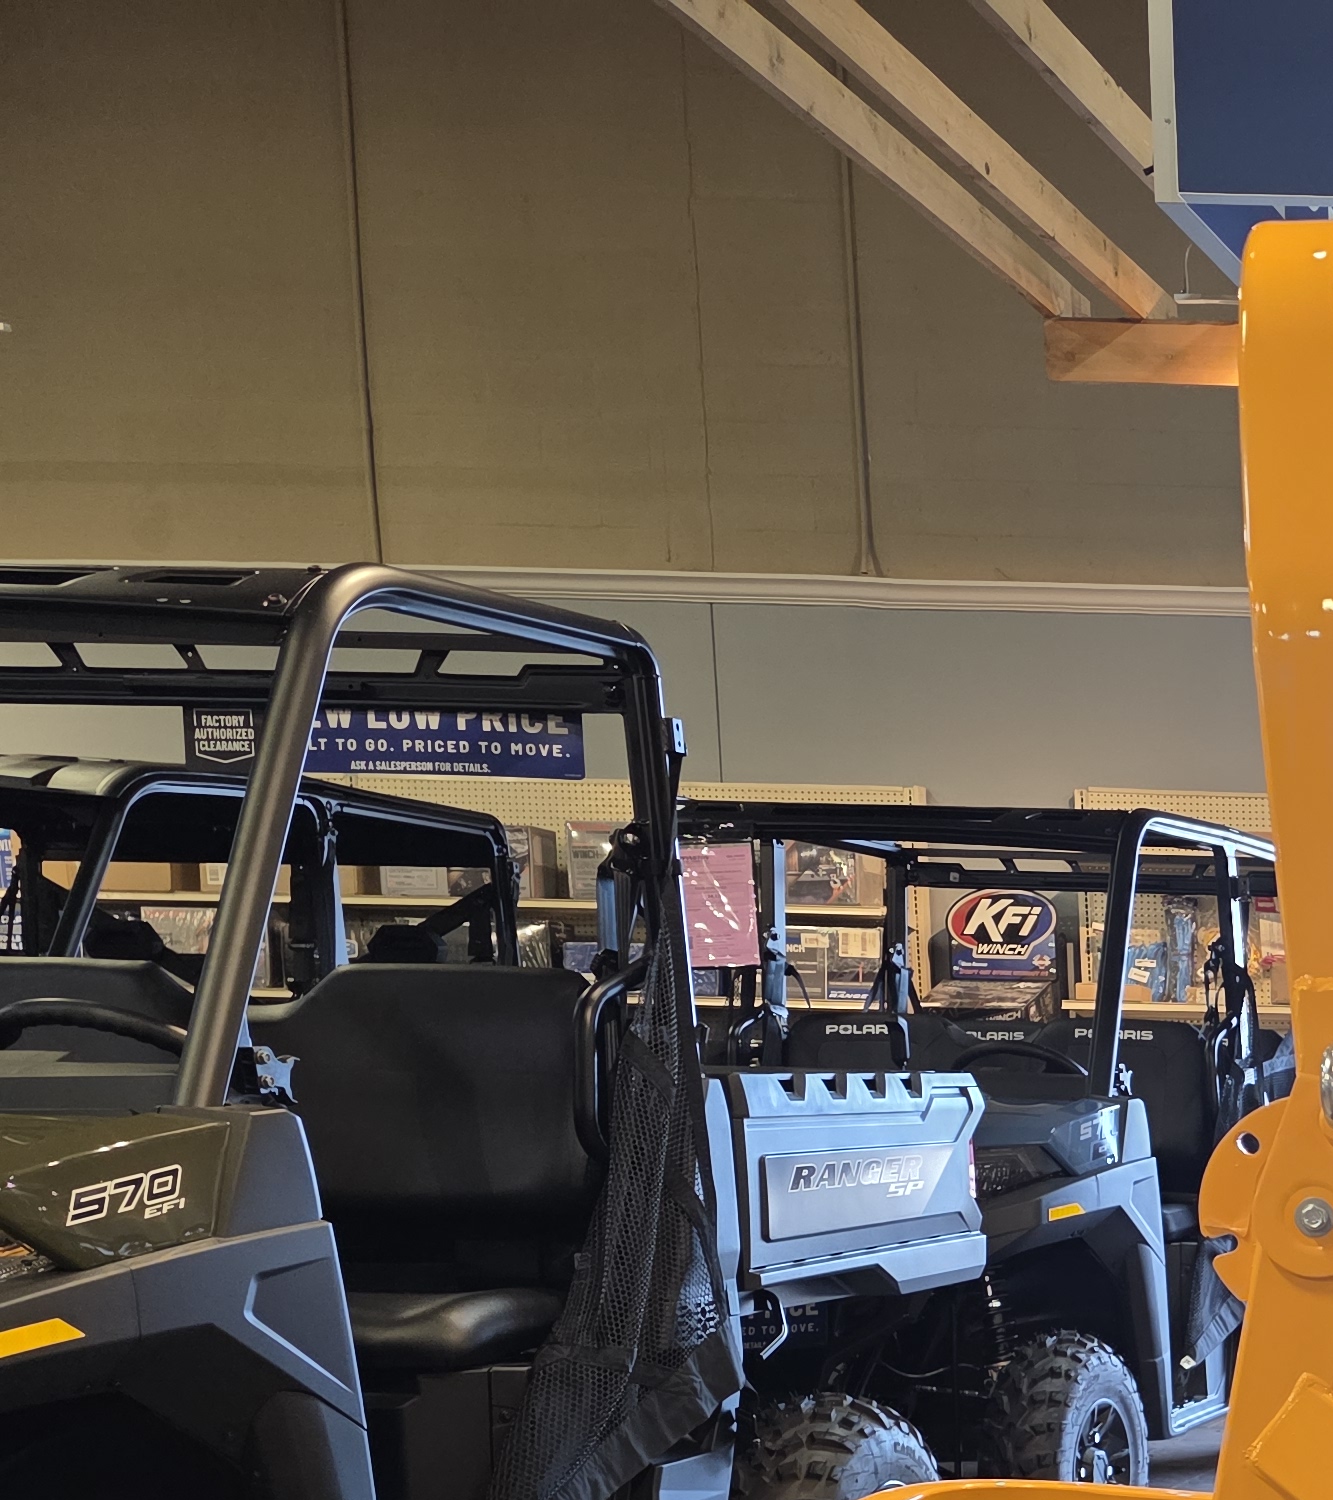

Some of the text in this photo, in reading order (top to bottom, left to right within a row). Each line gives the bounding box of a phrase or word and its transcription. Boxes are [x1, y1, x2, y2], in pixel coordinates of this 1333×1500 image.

[201, 715, 245, 727] FACTORY
[194, 728, 255, 740] AUTHORIZED
[200, 741, 250, 752] CLEARANCE
[336, 738, 357, 751] TO
[365, 739, 395, 752] GO.
[403, 739, 470, 753] PRICED
[478, 742, 502, 755] TO
[511, 743, 571, 758] MOVE.
[351, 761, 491, 773] ASK A SALESPERSON FOR DETAILS.
[977, 943, 1028, 955] WINCH
[825, 1024, 888, 1035] POLAR
[1075, 1028, 1154, 1040] PARIS
[966, 1031, 1024, 1041] LARIS
[788, 1154, 925, 1198] RANGER SP
[65, 1163, 186, 1227] 570 EFI
[790, 1322, 819, 1334] OVE.
